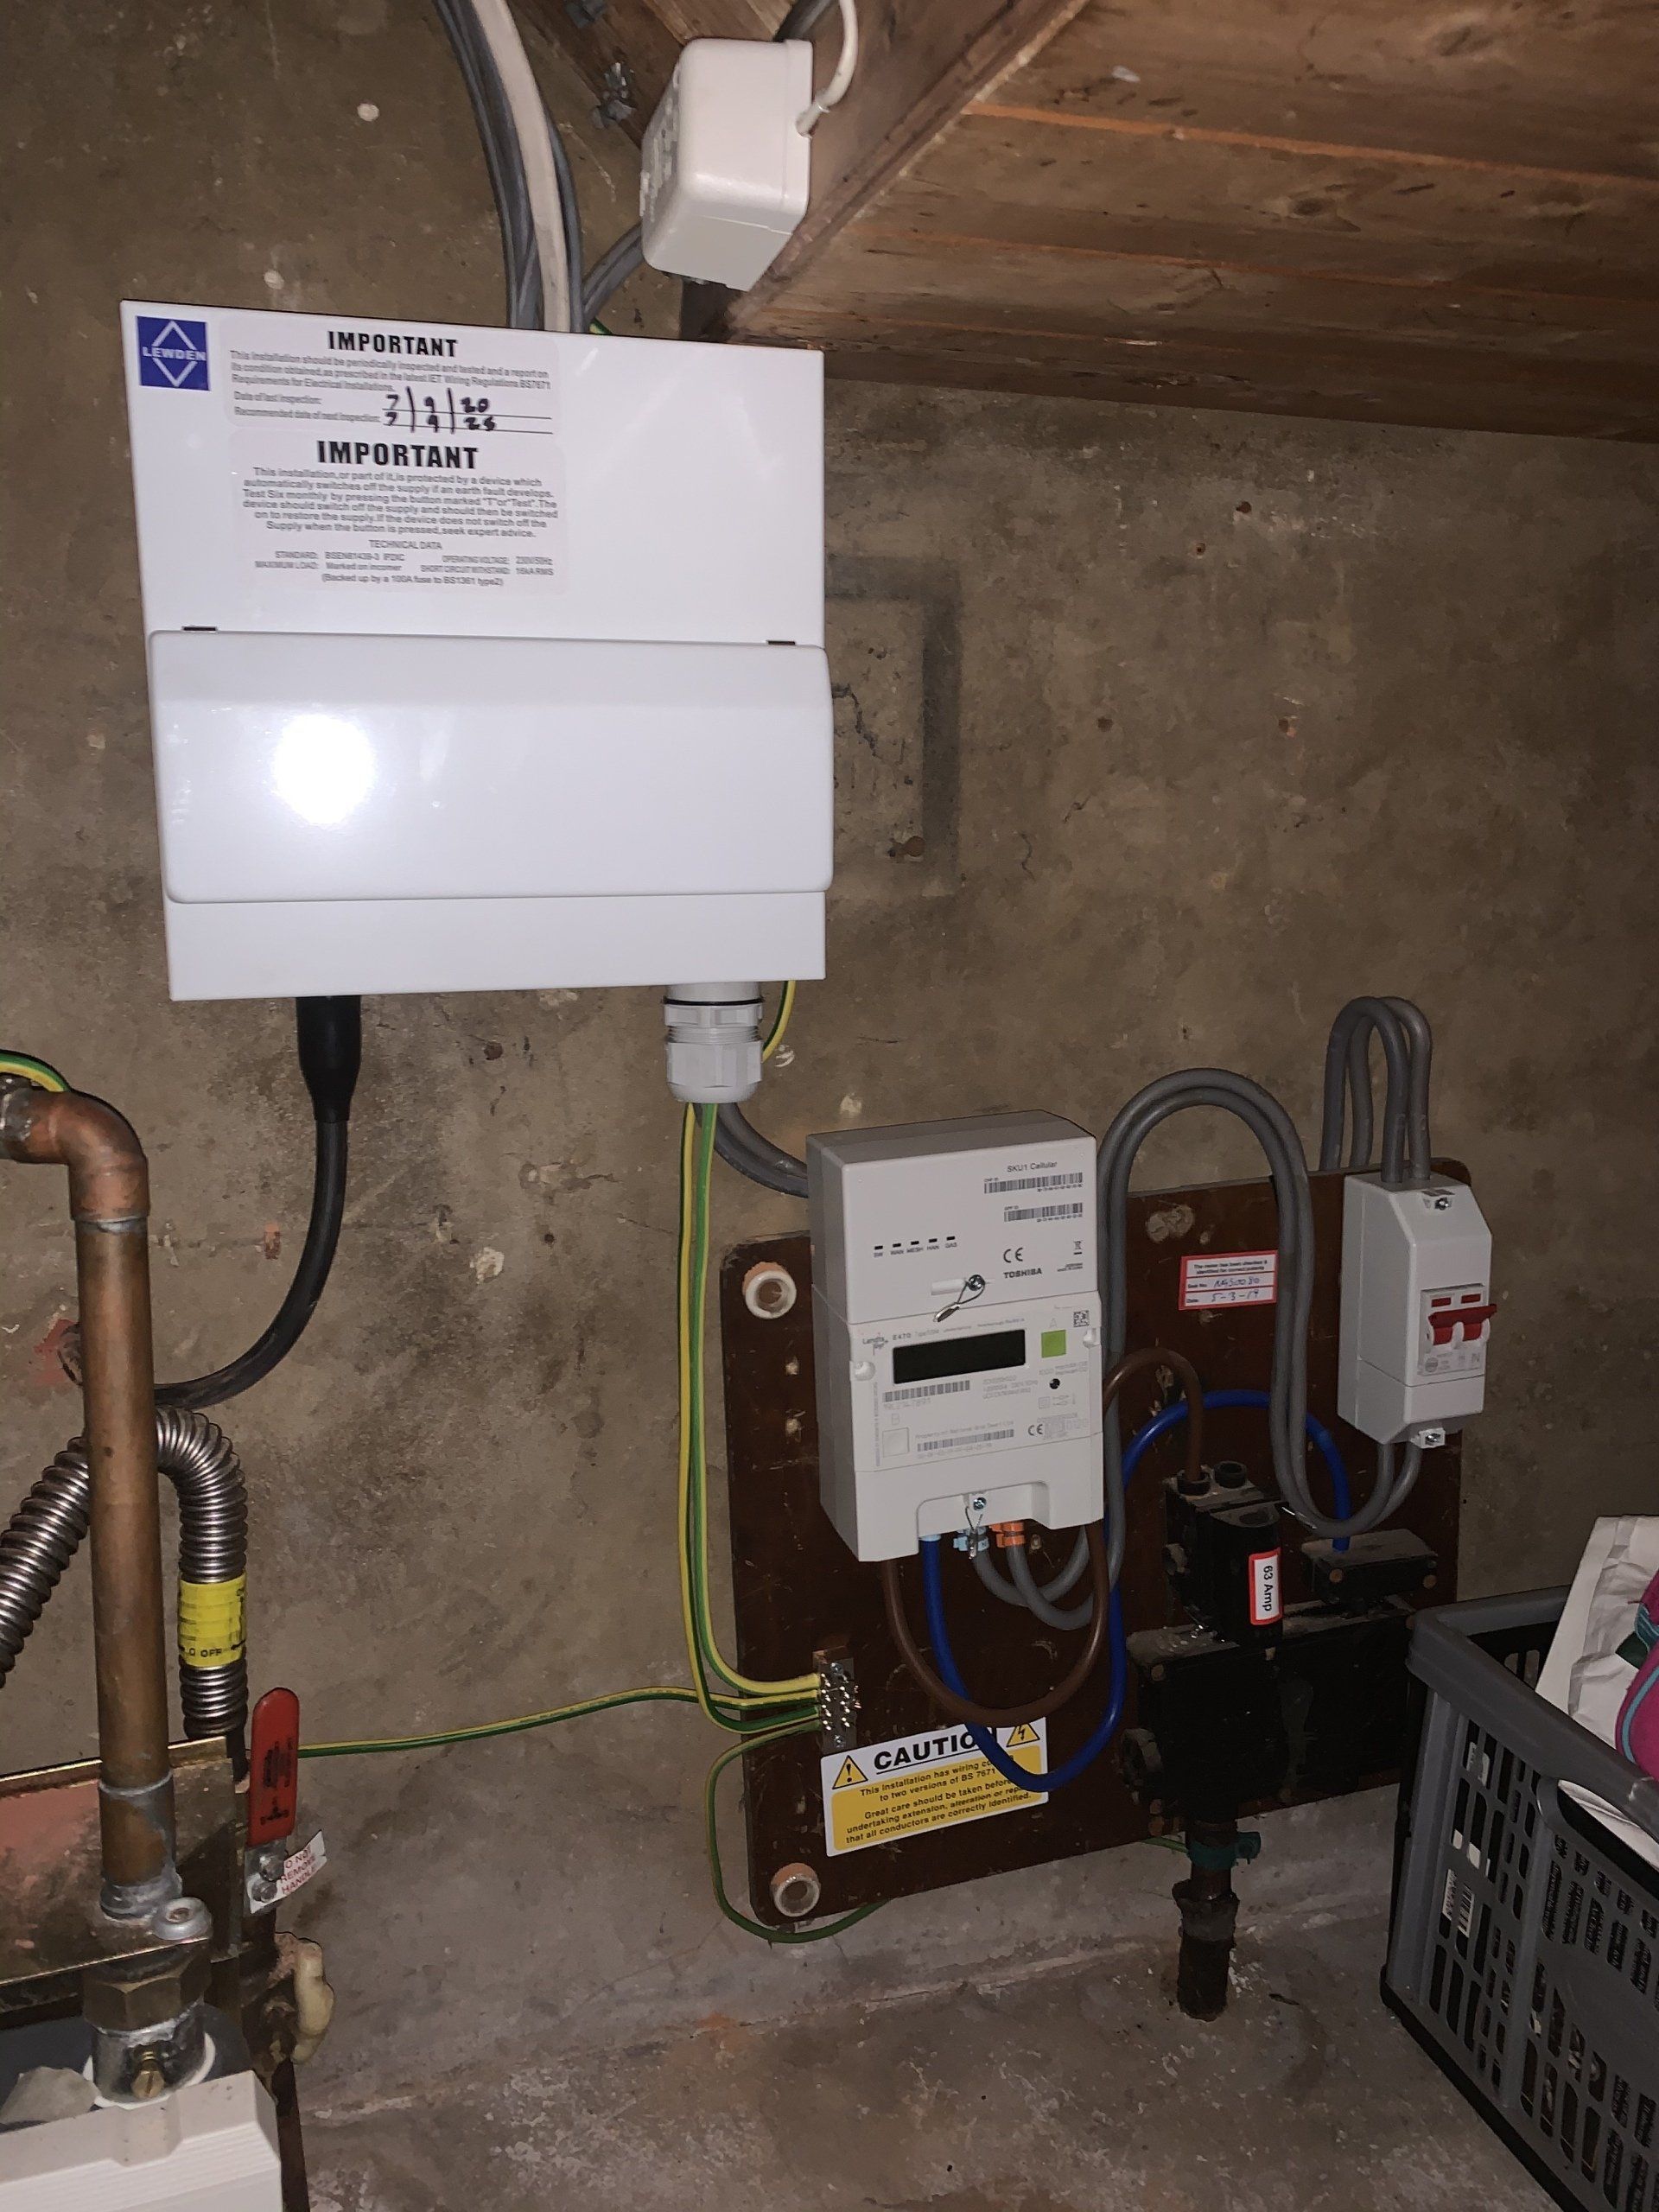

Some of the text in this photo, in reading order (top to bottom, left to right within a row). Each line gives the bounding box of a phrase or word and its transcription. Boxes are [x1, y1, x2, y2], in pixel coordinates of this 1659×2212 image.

[142, 346, 207, 361] LEWDEN
[327, 330, 458, 358] IMPORTANT
[316, 441, 479, 469] IMPORTANT
[253, 467, 276, 476] This
[351, 471, 372, 480] part
[407, 473, 455, 484] protected
[456, 474, 468, 484] by
[479, 475, 511, 485] device
[513, 477, 543, 486] which
[244, 478, 314, 489] automatically
[315, 480, 361, 490] switches
[363, 482, 378, 491] off
[397, 483, 430, 493] supply
[455, 486, 481, 494] earth
[482, 486, 505, 495] fault
[243, 488, 265, 497] Test
[267, 489, 284, 498] Six
[286, 490, 327, 500] monthly
[330, 492, 343, 501] by
[345, 492, 389, 502] pressing
[391, 493, 407, 502] the
[409, 494, 442, 503] button
[443, 495, 480, 505] marked
[243, 499, 277, 508] device
[279, 500, 315, 510] should
[317, 502, 349, 511] switch
[351, 503, 365, 512] off
[385, 504, 418, 514] supply
[442, 506, 474, 515] should
[476, 507, 499, 516] then
[515, 508, 558, 518] switched
[270, 510, 280, 518] to
[283, 511, 320, 519] restore
[321, 512, 338, 520] the
[404, 514, 436, 524] device
[483, 517, 514, 525] switch
[516, 518, 529, 526] off
[531, 518, 547, 527] the
[266, 520, 302, 531] Supply
[304, 521, 332, 530] when
[353, 523, 385, 531] button
[467, 526, 499, 537] expert
[1007, 1161, 1058, 1173] SKU1 Cellular
[1003, 1268, 1042, 1279] TOSHIBA
[1262, 1565, 1274, 1611] 63 Amp
[874, 1728, 997, 1770] CAUTIO
[860, 1763, 978, 1796] This installation has wiring
[891, 1789, 906, 1798] two
[909, 1779, 947, 1794] versions
[961, 1771, 973, 1782] BS
[864, 1805, 889, 1819] Great
[891, 1802, 911, 1812] care
[912, 1792, 943, 1807] should
[945, 1790, 957, 1799] be
[958, 1784, 982, 1796] taken
[846, 1831, 863, 1843] that
[866, 1827, 877, 1838] all
[879, 1816, 930, 1834] conductors
[931, 1813, 945, 1822] are
[947, 1802, 985, 1818] correctly
[847, 1815, 899, 1833] undertaking
